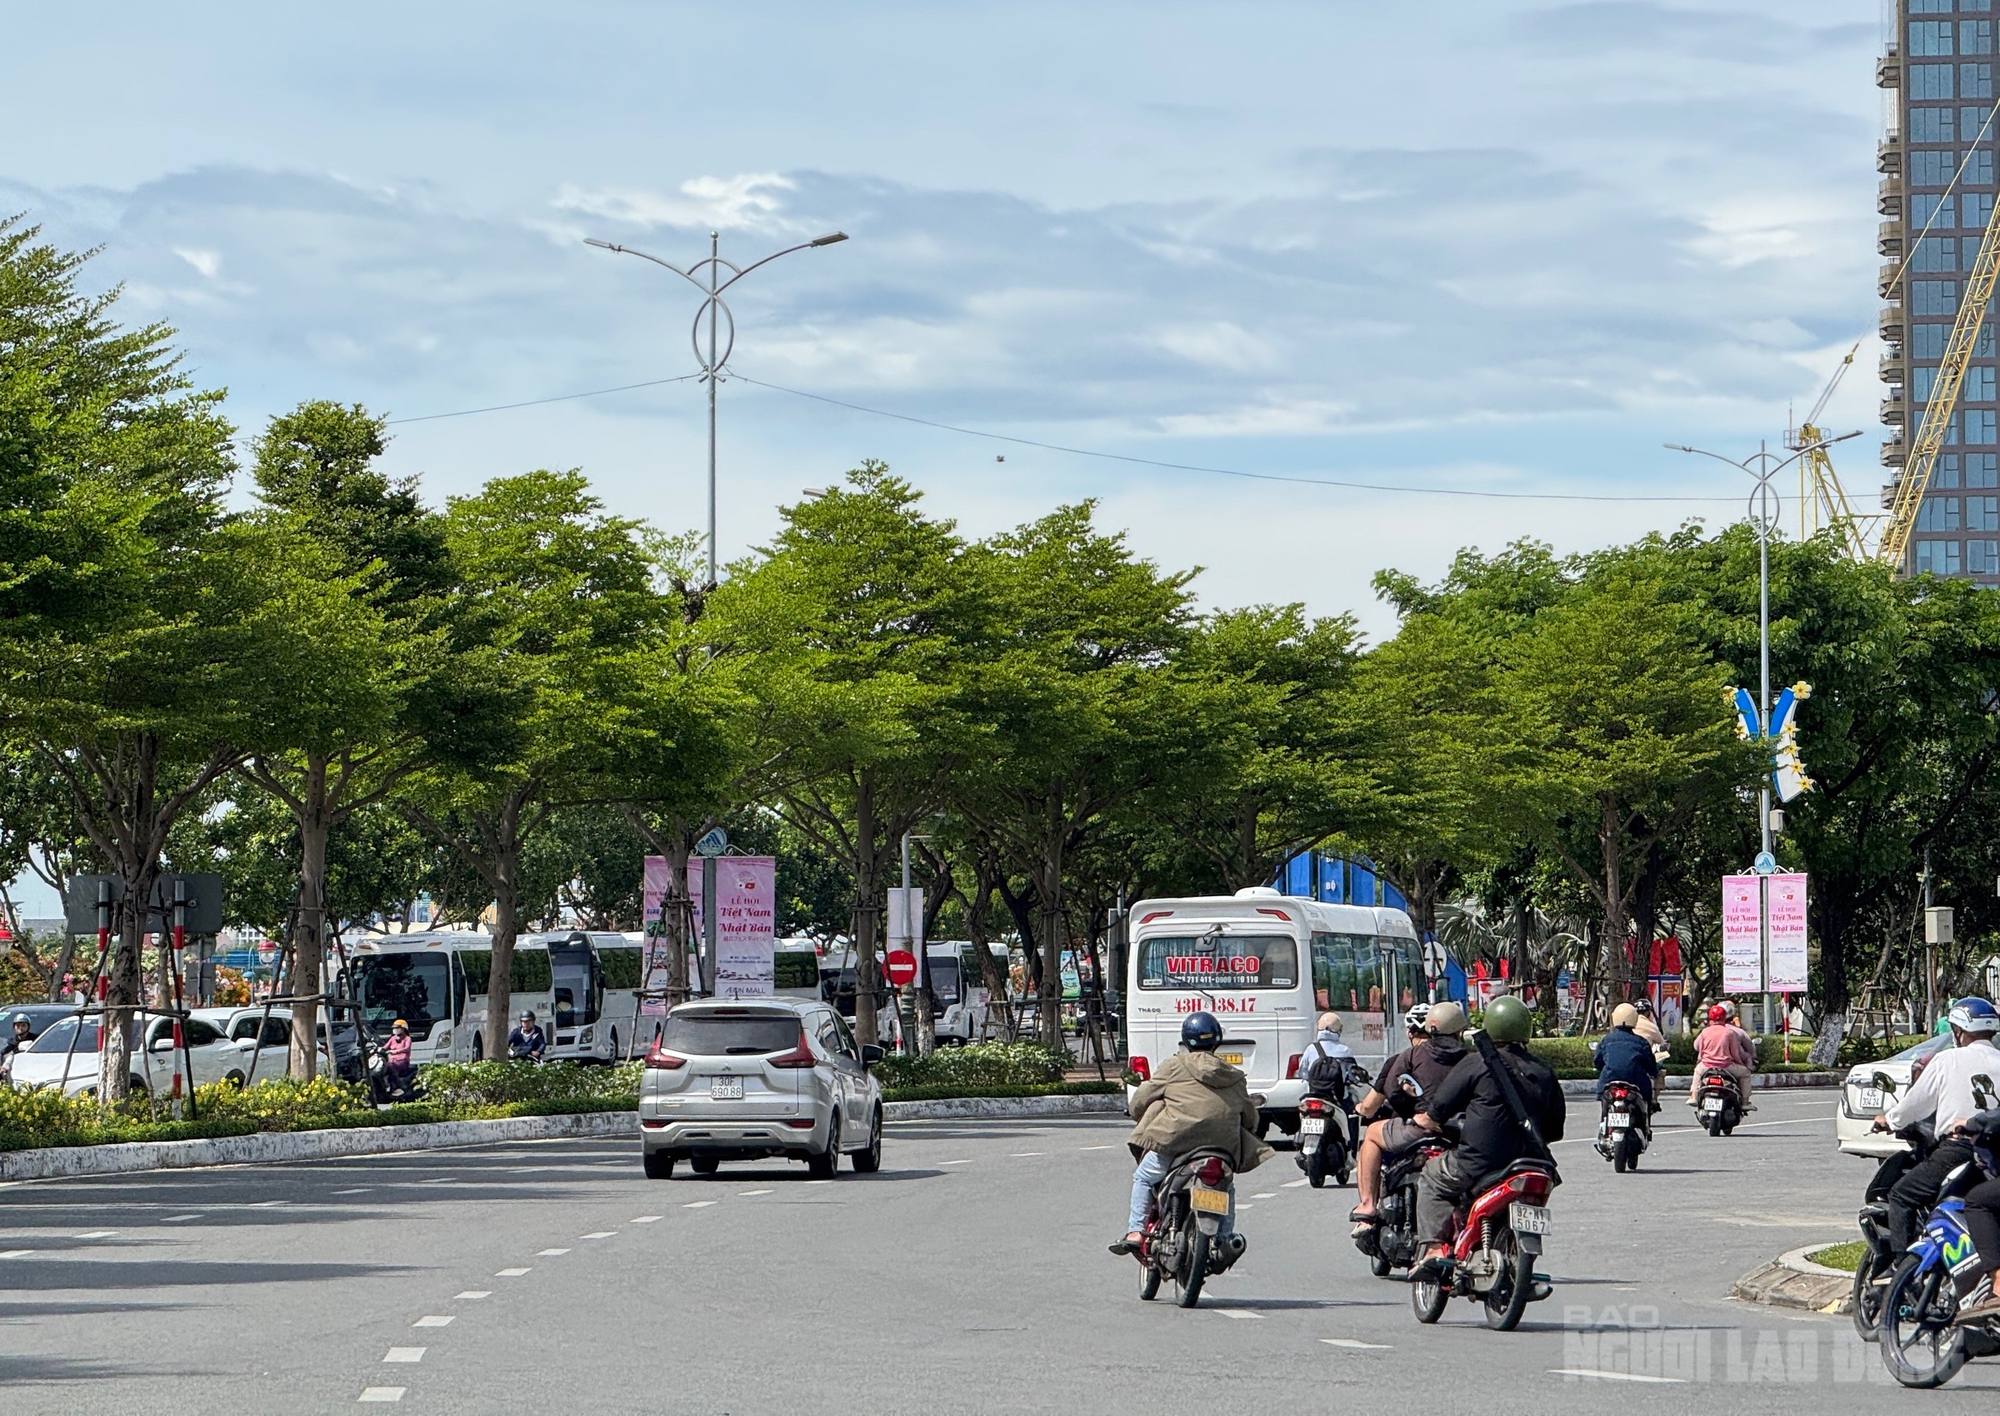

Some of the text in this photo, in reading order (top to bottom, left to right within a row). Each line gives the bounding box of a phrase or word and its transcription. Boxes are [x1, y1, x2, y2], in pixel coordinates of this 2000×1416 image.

[720, 907, 771, 919] Việt Nam
[719, 922, 772, 935] Nhật Bản
[1166, 955, 1260, 974] VITRACO
[719, 1077, 735, 1086] 30F
[712, 1087, 742, 1097] 690.88
[1517, 1219, 1546, 1232] 5067
